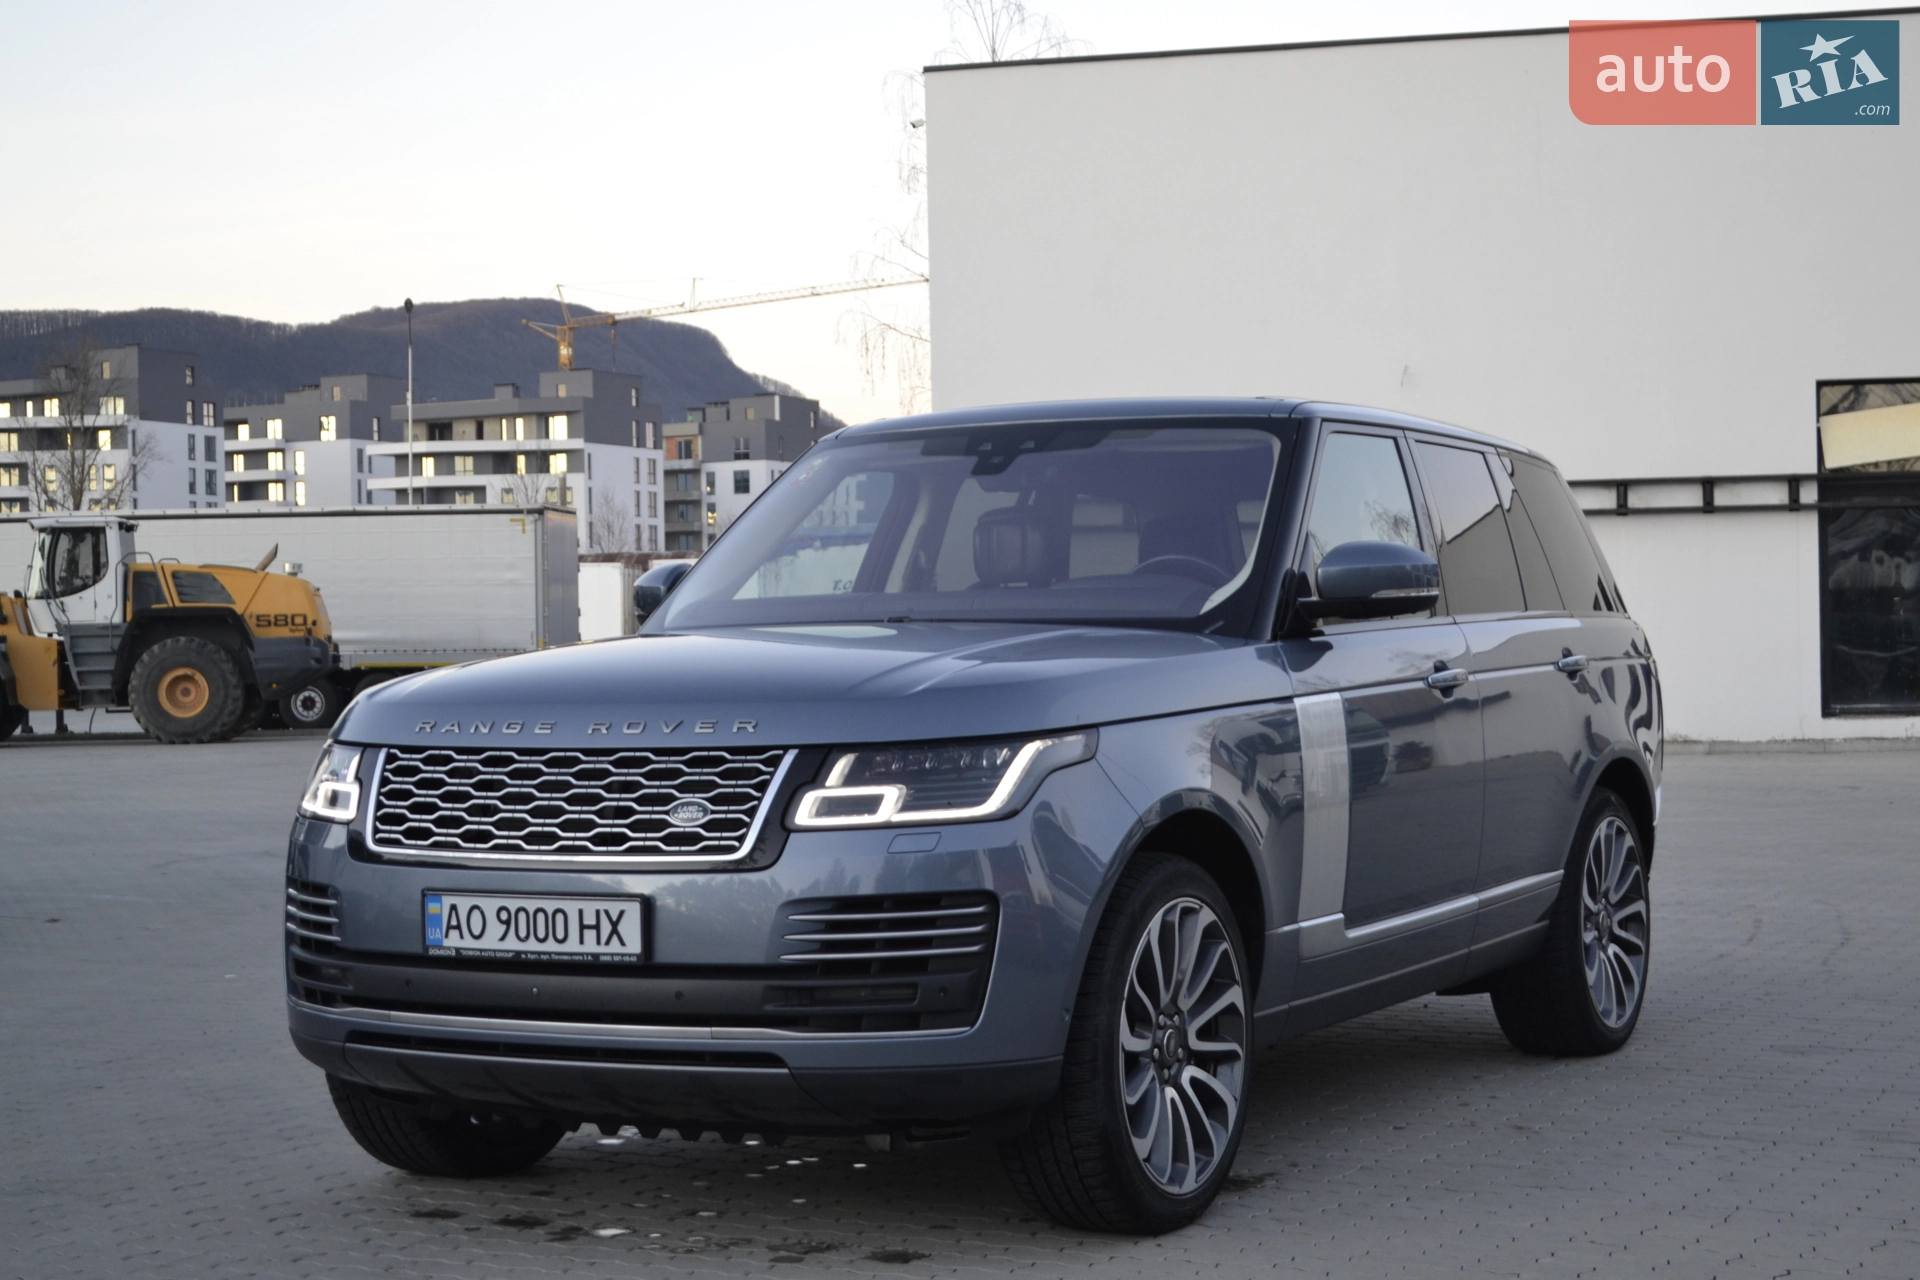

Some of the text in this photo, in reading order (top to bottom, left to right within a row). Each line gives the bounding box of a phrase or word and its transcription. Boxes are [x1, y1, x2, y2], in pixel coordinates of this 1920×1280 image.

[255, 614, 307, 627] 580
[414, 718, 758, 734] RANGE ROVER
[677, 811, 704, 819] ROVER
[444, 903, 627, 947] AO 9000 HX
[428, 927, 442, 940] UA
